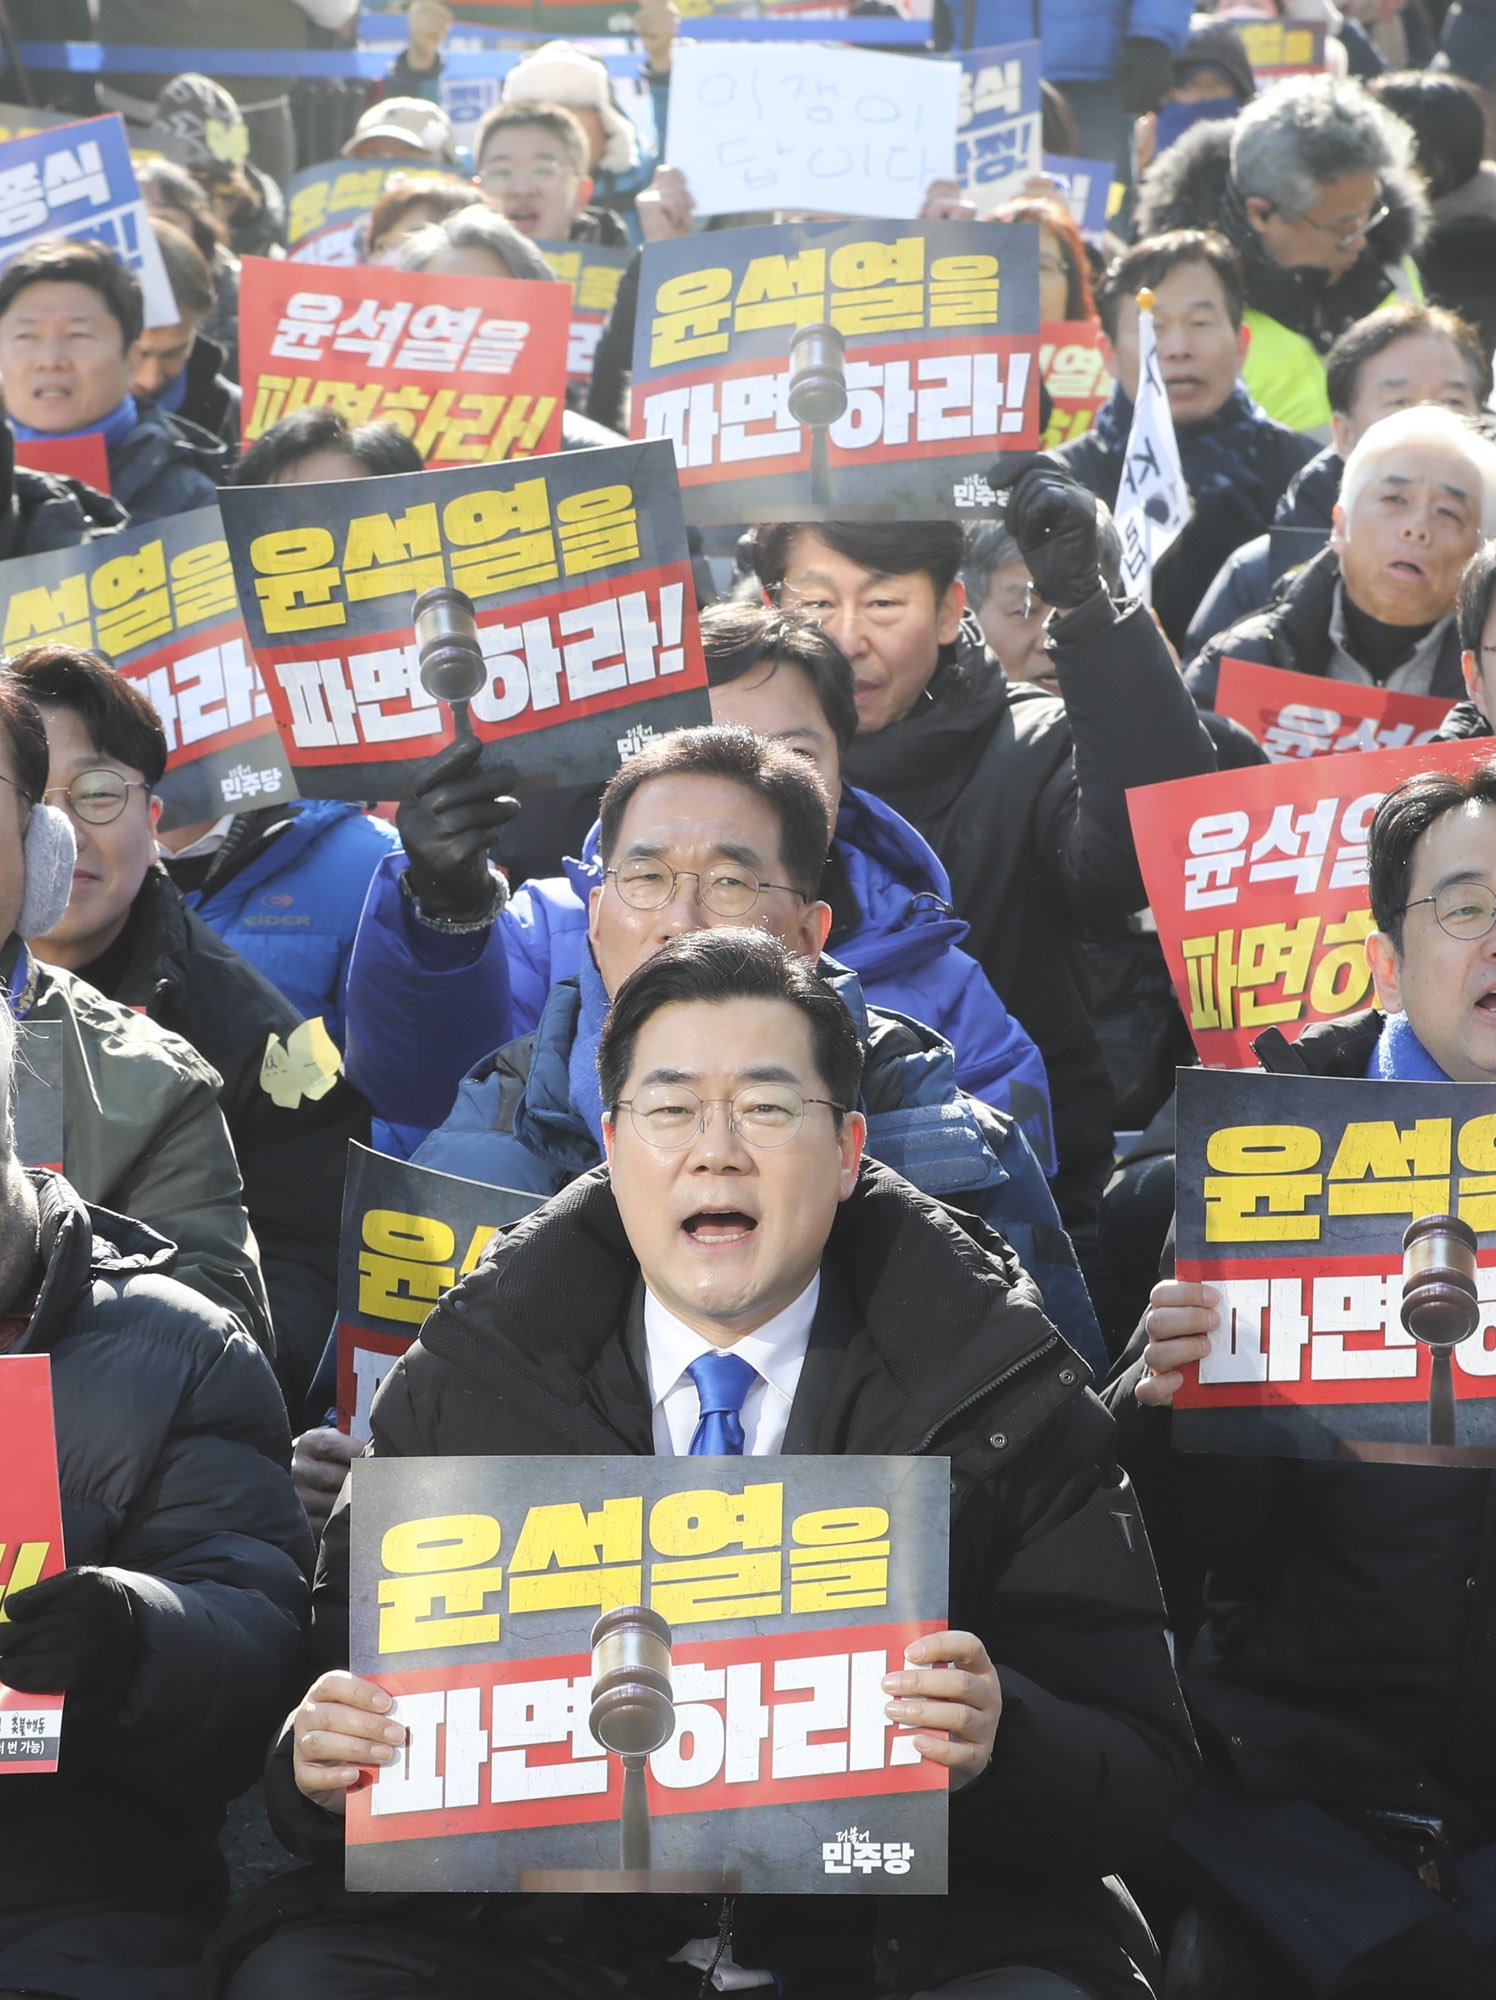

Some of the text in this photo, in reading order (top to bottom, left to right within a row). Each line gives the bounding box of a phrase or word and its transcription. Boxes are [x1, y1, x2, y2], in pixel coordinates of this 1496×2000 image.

[269, 292, 530, 374] 윤석열을
[649, 237, 999, 368] 윤석열을
[643, 353, 1032, 471] 파면하라!
[249, 477, 639, 634] 윤석열을
[274, 582, 684, 749] 파면하라!
[220, 767, 282, 803] 민주당
[358, 1208, 498, 1326] 윤
[377, 1482, 890, 1655] 윤석열을
[19, 1740, 45, 1756] 가능)
[822, 1842, 915, 1875] 민주당
[836, 1826, 870, 1845] 더불어
